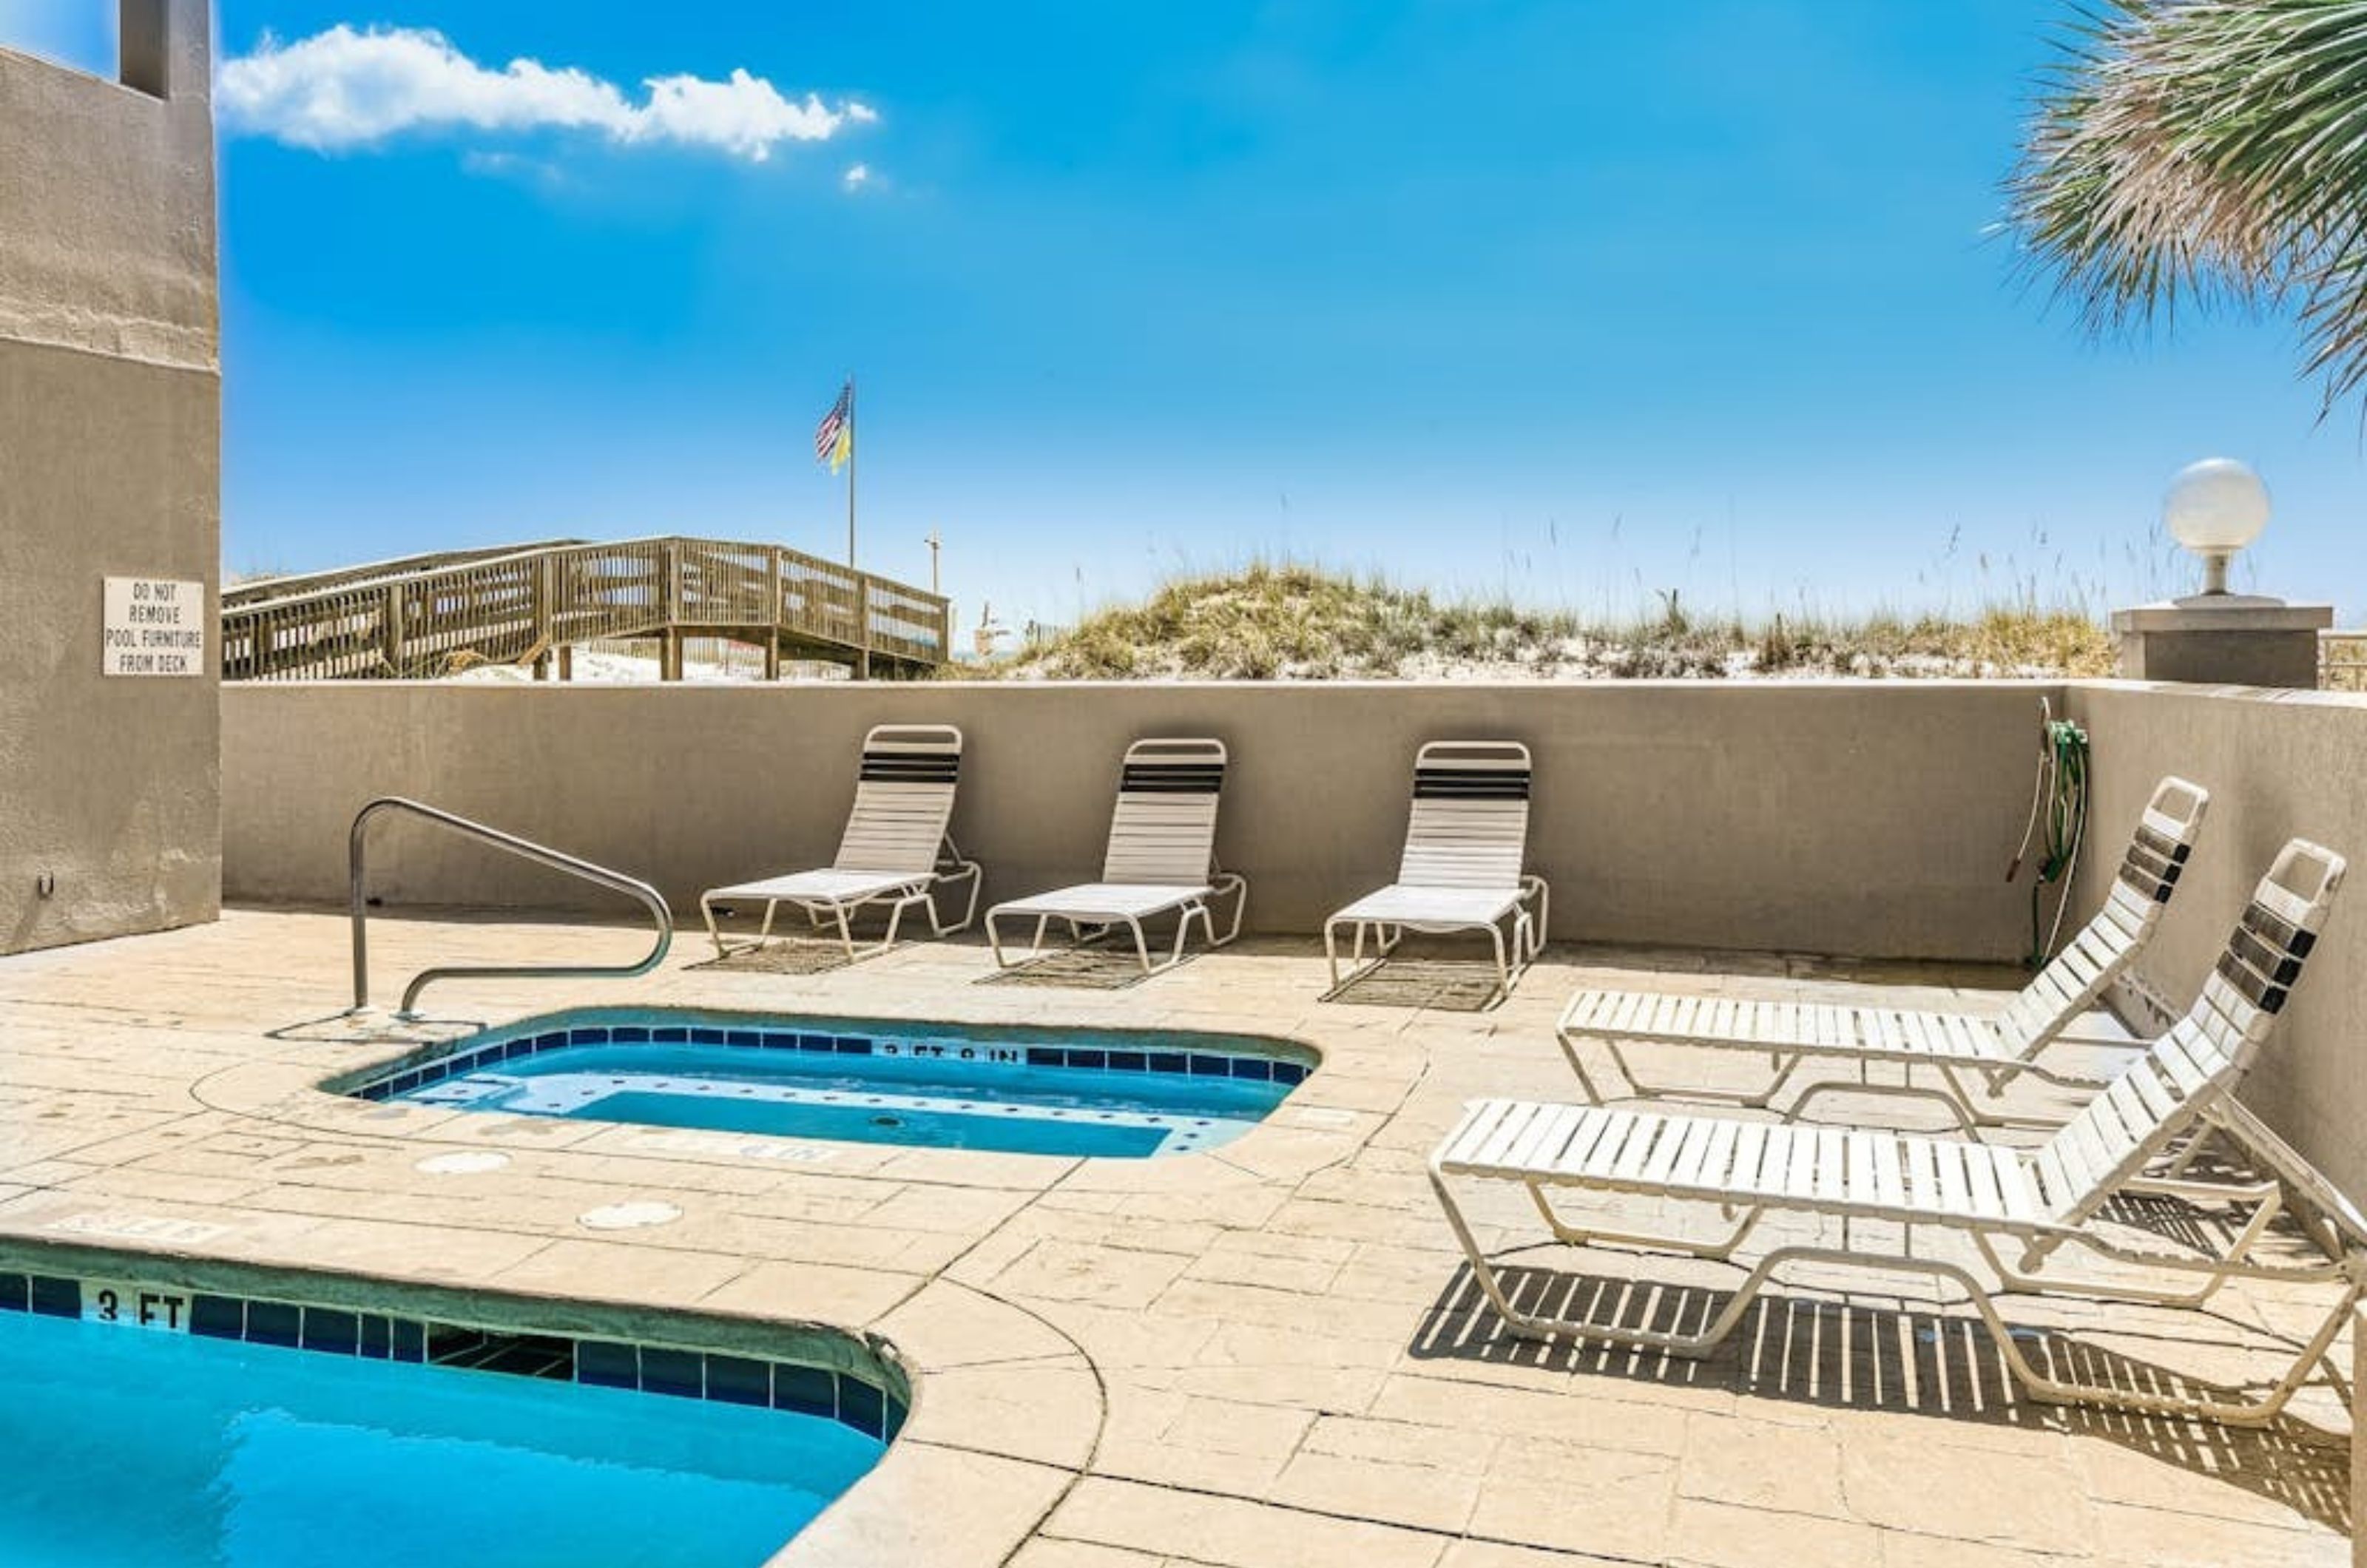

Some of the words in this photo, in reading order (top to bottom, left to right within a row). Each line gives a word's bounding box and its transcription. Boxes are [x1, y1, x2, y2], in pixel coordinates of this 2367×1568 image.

[133, 583, 150, 601] DO
[155, 584, 177, 601] NOT
[129, 605, 180, 624] REMOVE
[107, 629, 137, 647] POOL
[143, 629, 201, 649] FURNITURE
[120, 655, 153, 672] FROM
[158, 655, 187, 672] DECK
[98, 1289, 118, 1320] 3
[140, 1292, 183, 1329] FT
